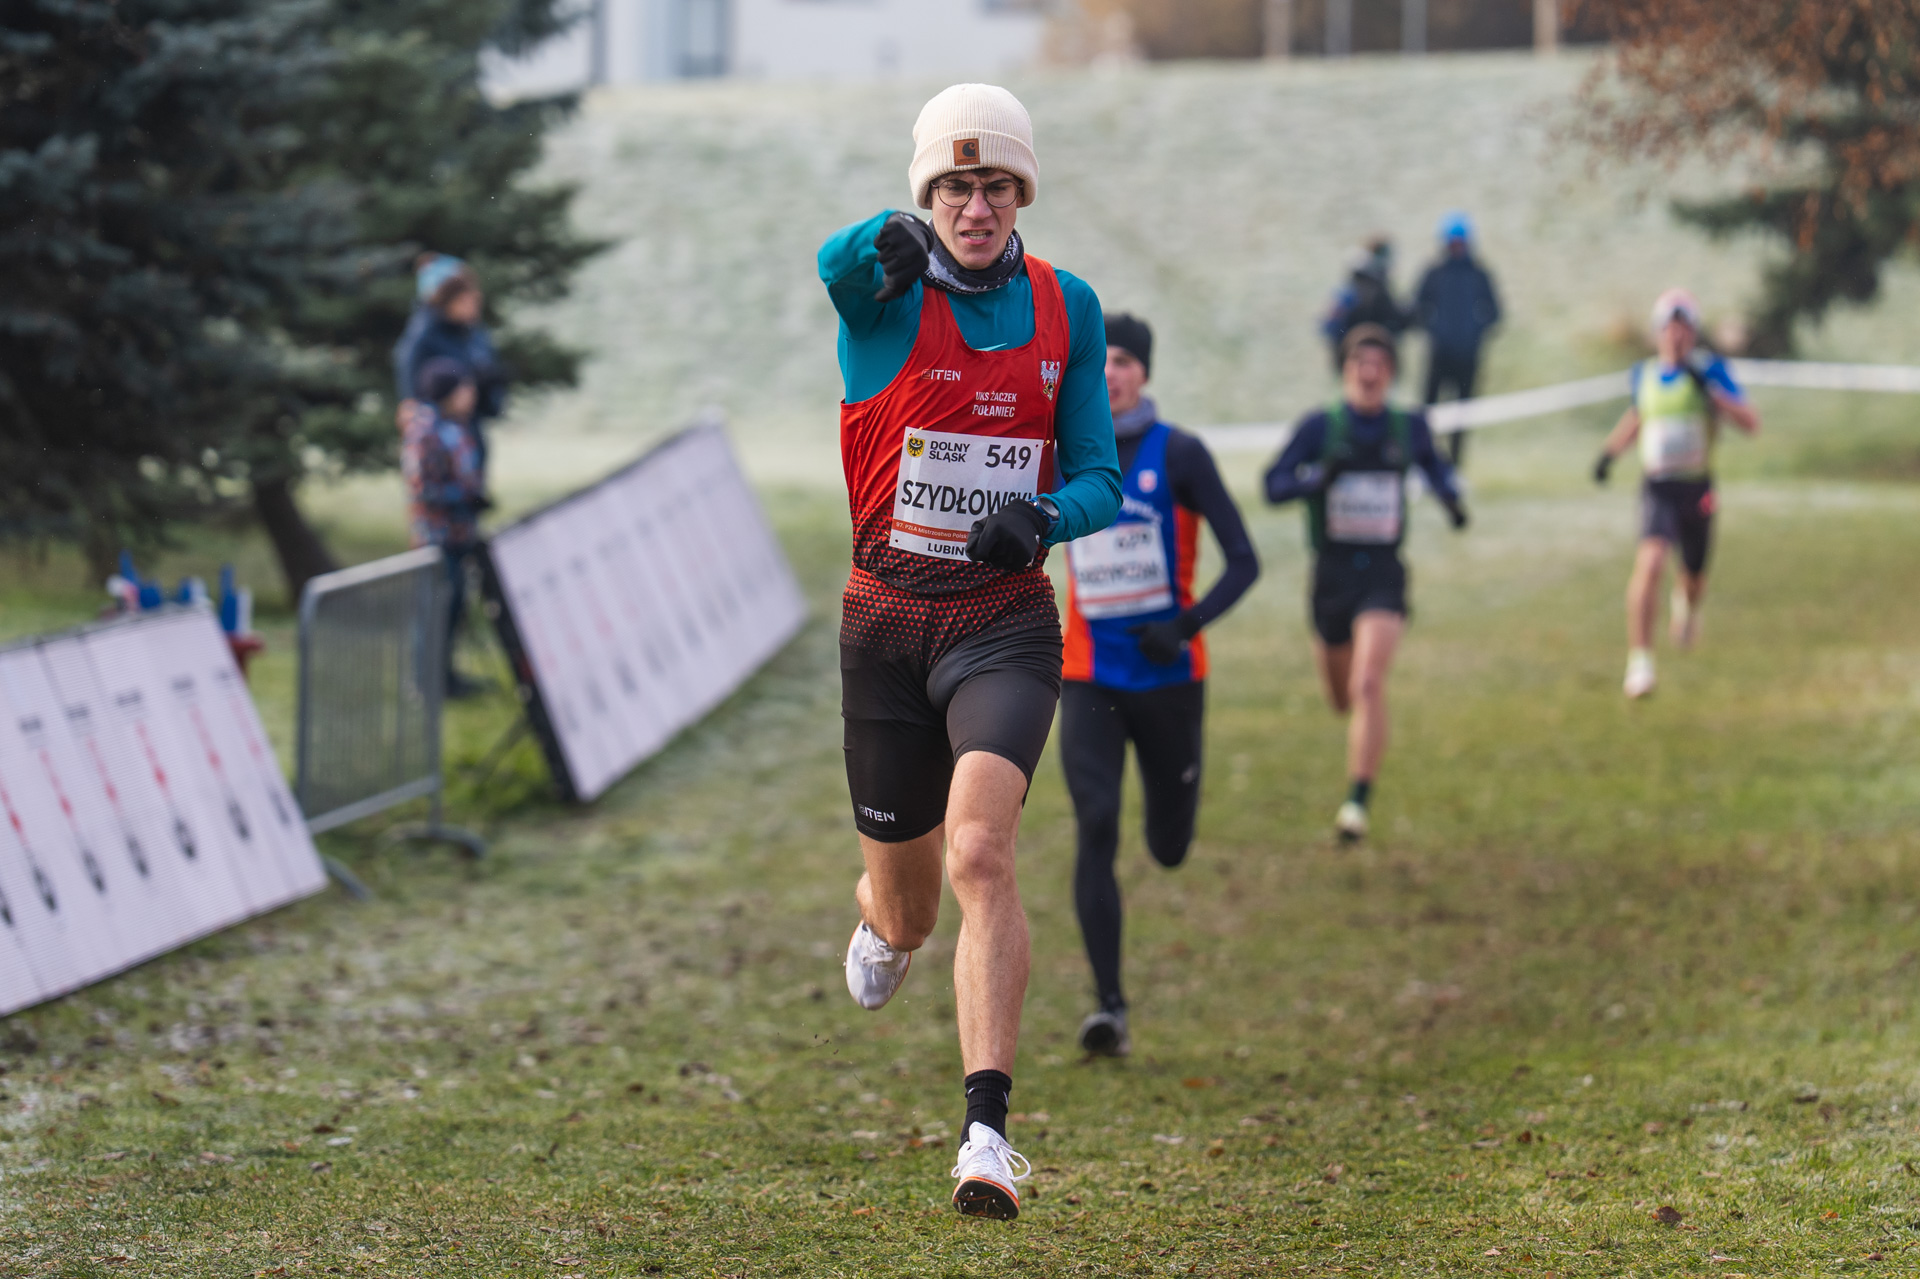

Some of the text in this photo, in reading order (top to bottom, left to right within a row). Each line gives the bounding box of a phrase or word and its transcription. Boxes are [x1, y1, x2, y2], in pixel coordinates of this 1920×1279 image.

[975, 390, 1018, 403] UKS ŻACZEK
[971, 404, 1016, 418] POŁANIEC
[930, 440, 970, 453] DOLNY
[928, 448, 967, 463] ŚLĄSK
[984, 444, 1032, 470] 549
[927, 542, 965, 556] LUBIN
